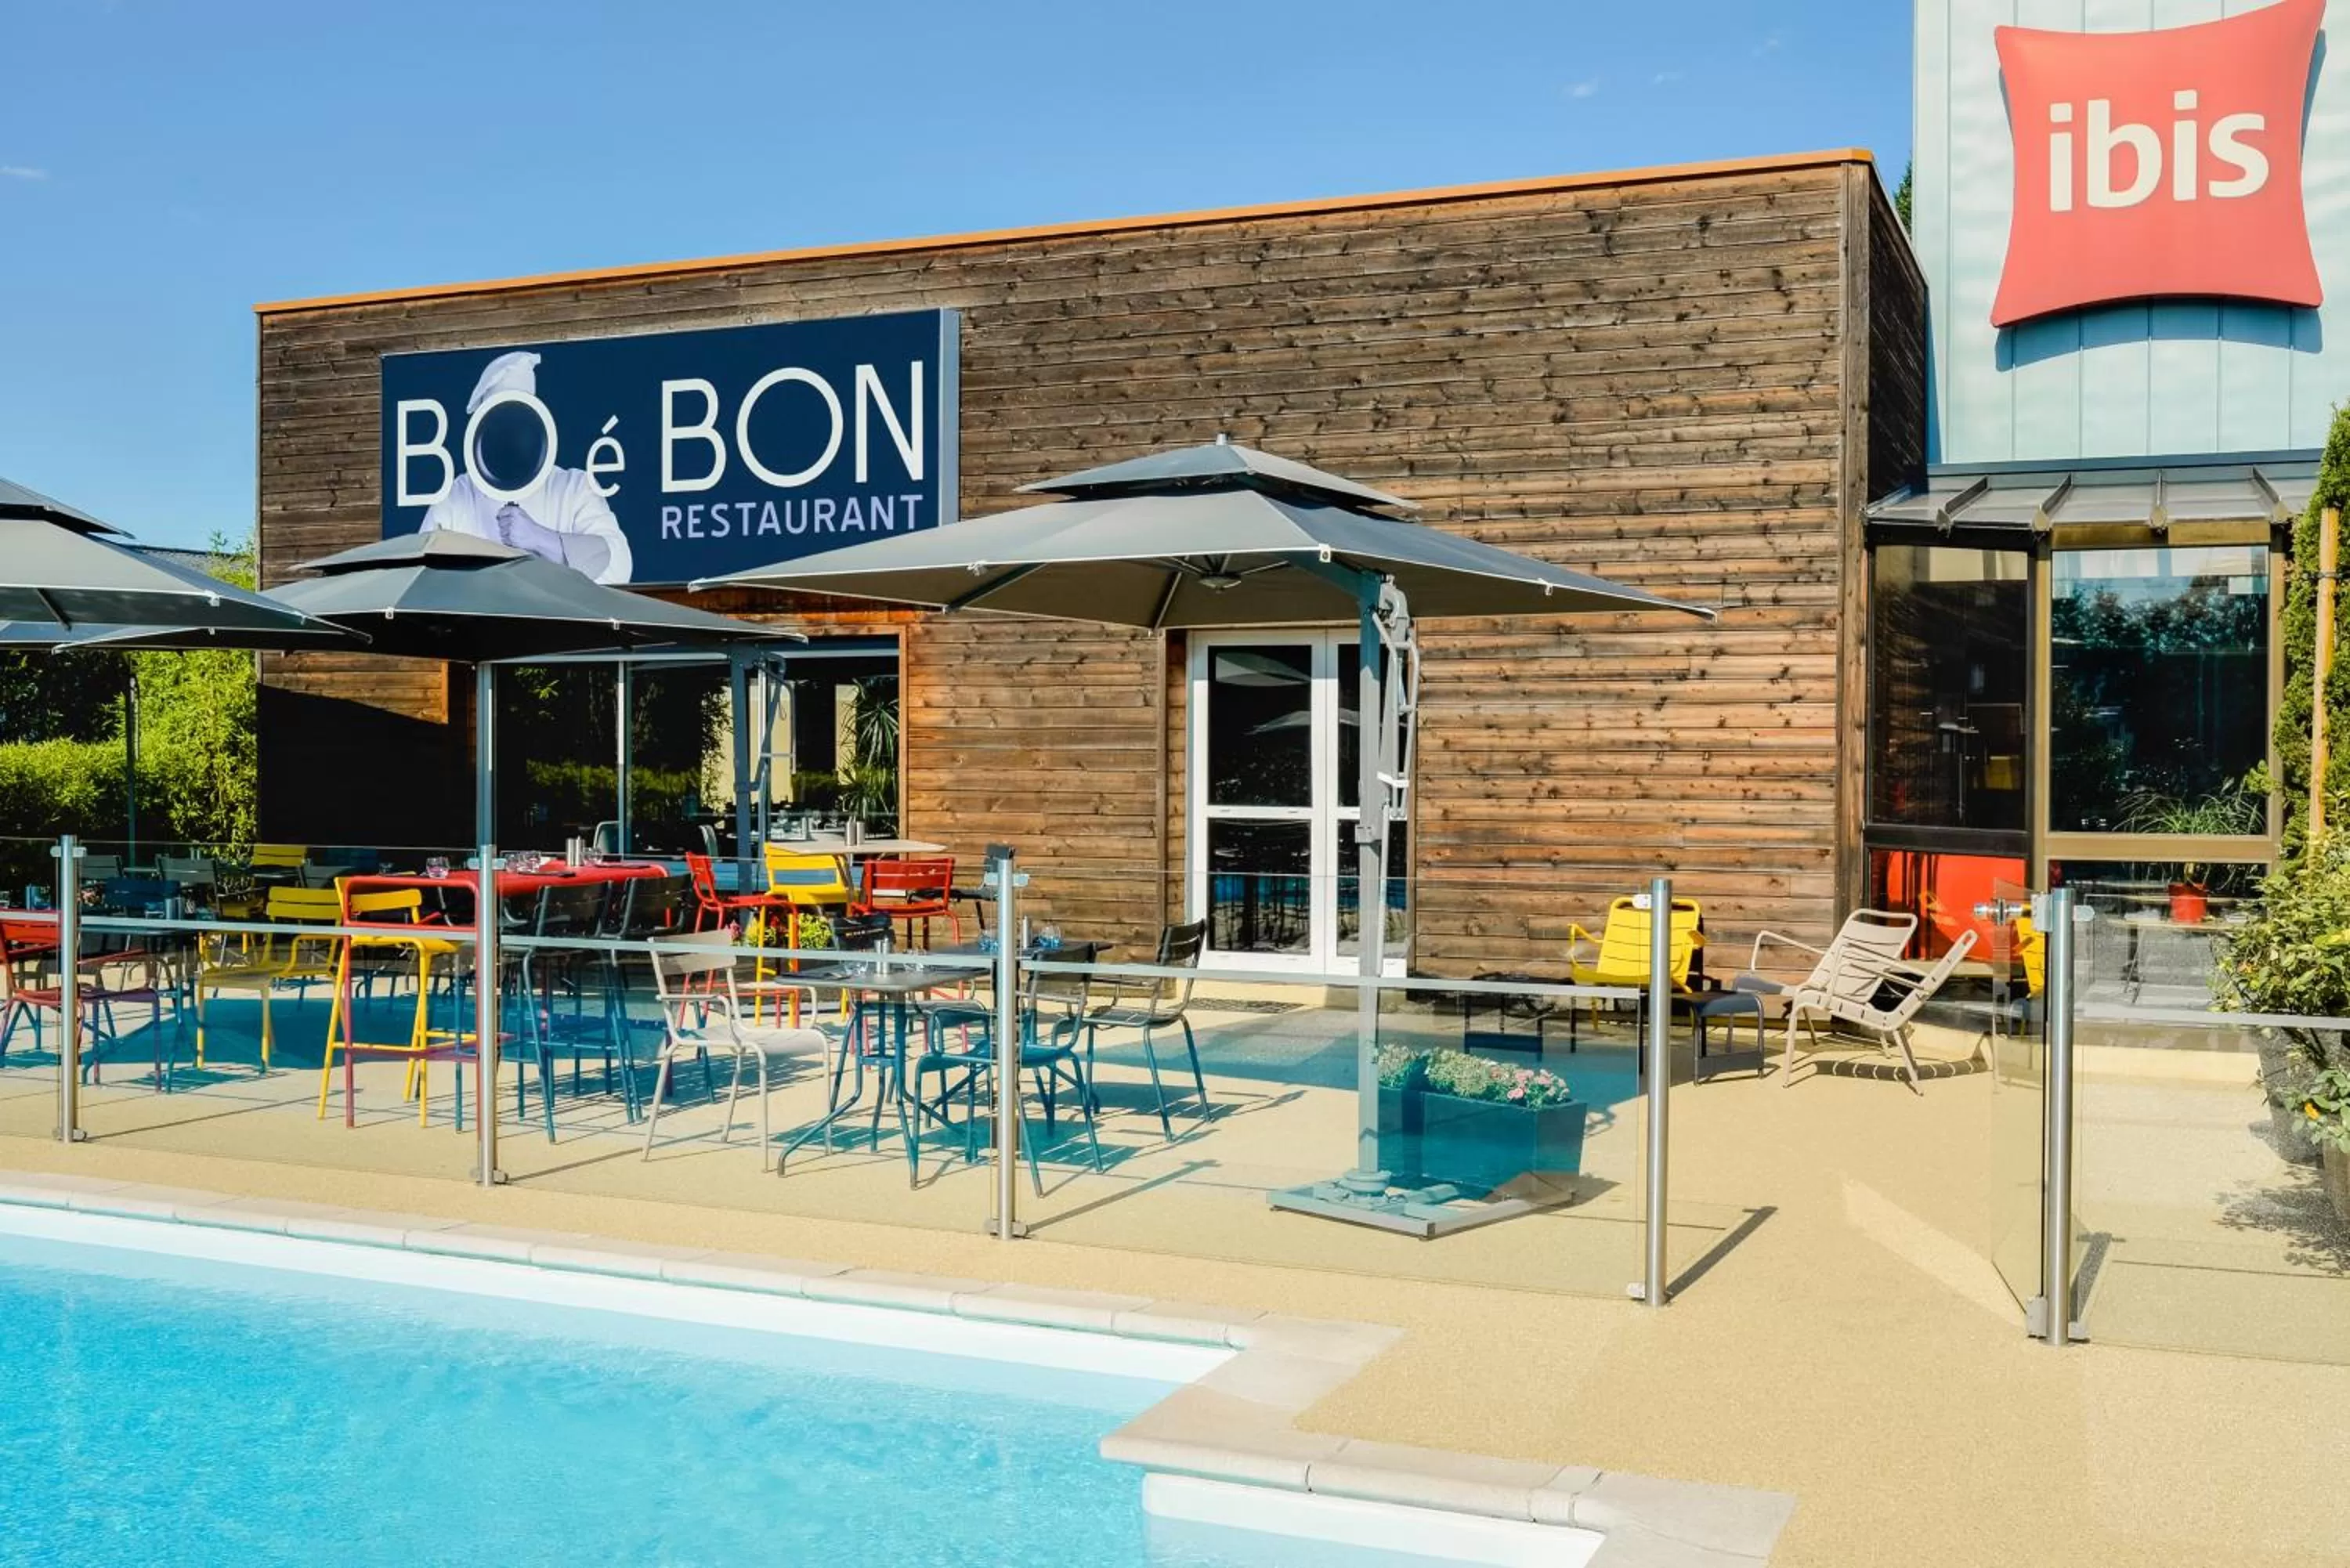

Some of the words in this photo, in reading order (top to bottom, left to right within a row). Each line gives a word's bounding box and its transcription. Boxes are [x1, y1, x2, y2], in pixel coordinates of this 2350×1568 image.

[2049, 89, 2269, 212] ibis
[661, 360, 924, 492] BON
[661, 494, 924, 540] RESTAURANT
